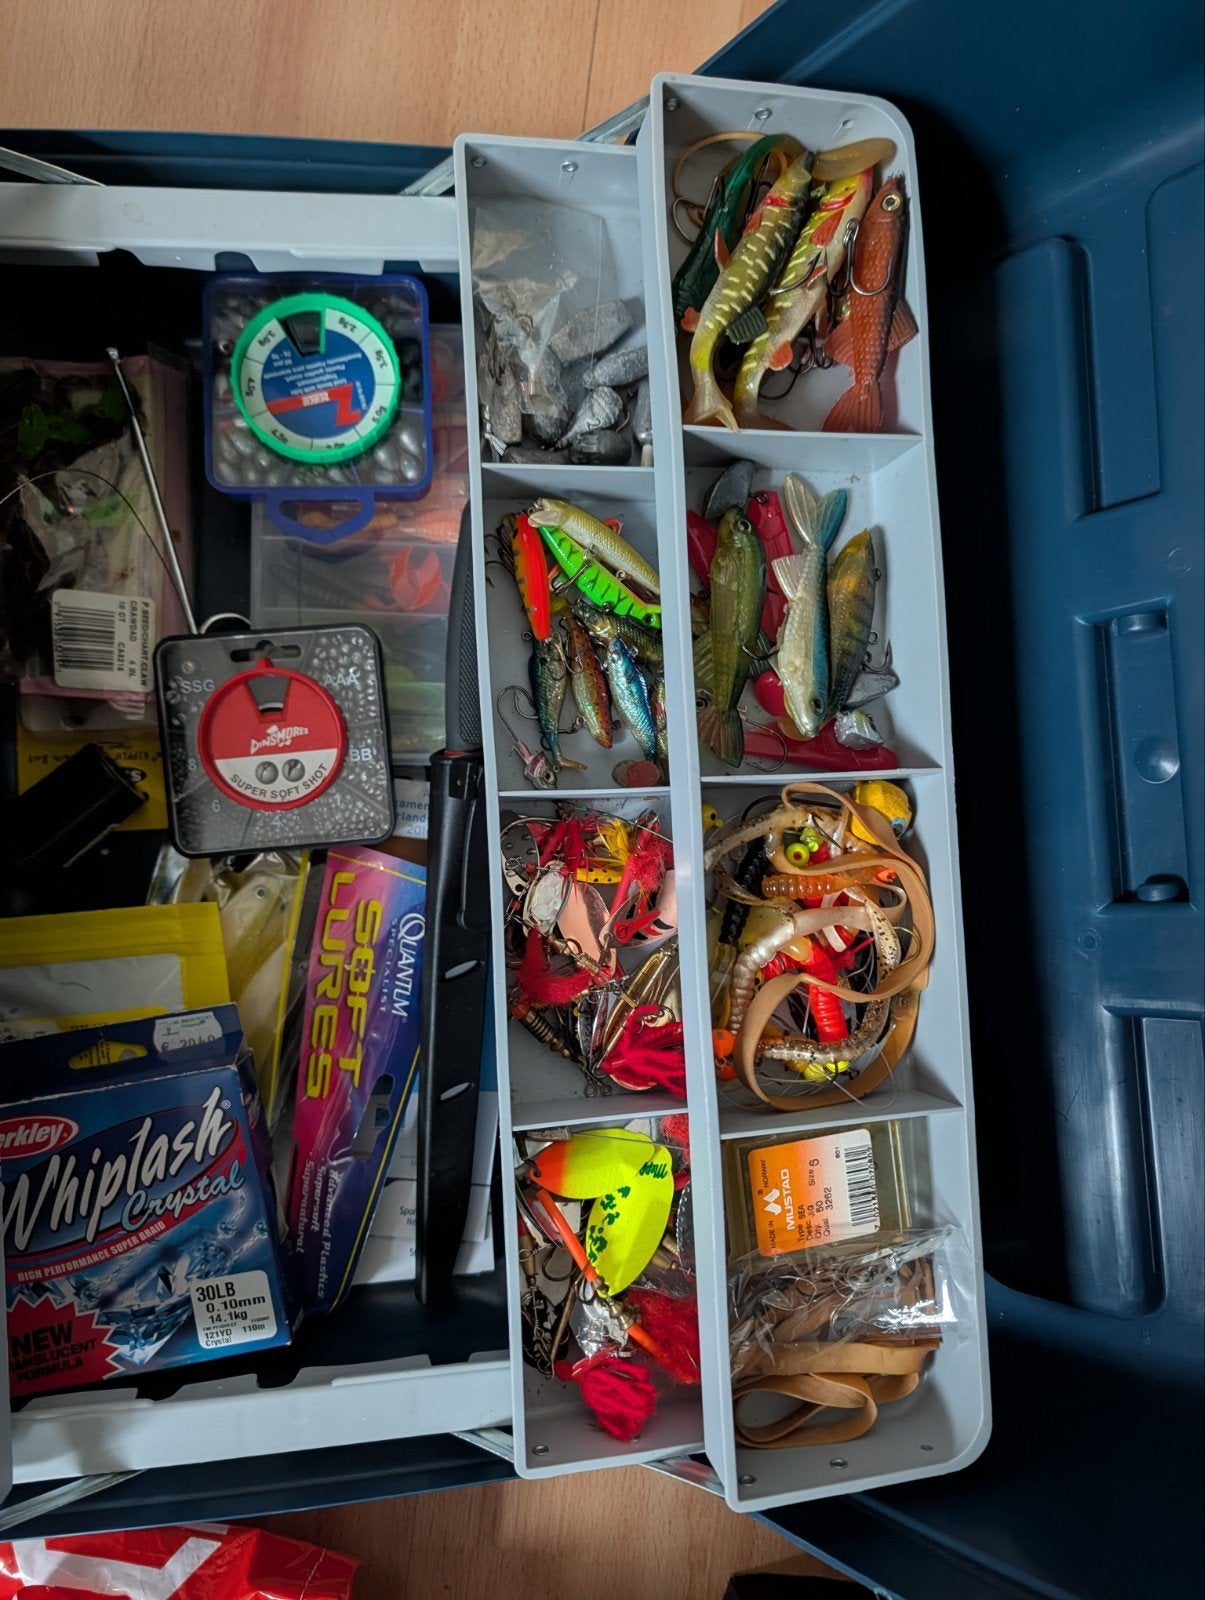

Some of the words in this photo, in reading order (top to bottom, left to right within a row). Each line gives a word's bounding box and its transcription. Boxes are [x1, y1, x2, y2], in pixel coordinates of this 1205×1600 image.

[338, 317, 358, 333] 2.5g
[245, 377, 257, 398] 4.0g
[118, 612, 126, 623] CT
[129, 600, 138, 642] CRAWDAD
[180, 678, 216, 694] SSG
[323, 671, 360, 688] AAA
[187, 758, 197, 772] 8
[350, 747, 374, 763] BB
[230, 773, 268, 799] SUPER
[270, 786, 301, 800] SOFT
[302, 762, 329, 790] SHOT
[211, 799, 222, 813] 6
[271, 814, 283, 827] 4
[379, 917, 398, 1013] SPECIALIST
[391, 912, 426, 1018] QUANTUM
[306, 871, 356, 1099] LURES
[338, 898, 383, 1089] SOFT
[0, 1122, 64, 1149] erkley
[0, 1087, 232, 1250] Whiplash
[760, 1159, 770, 1189] NORWAY
[808, 1169, 816, 1187] Size
[121, 1160, 244, 1231] Crystal
[310, 1164, 326, 1232] Supersoft
[780, 1167, 796, 1232] MUSTAD
[295, 1160, 315, 1254] Supernatural
[797, 1203, 806, 1219] SEA
[797, 1223, 806, 1242] Type
[17, 1270, 43, 1282] HIGH
[44, 1249, 110, 1278] PERFORMANCE
[110, 1236, 141, 1256] SUPER
[140, 1220, 166, 1241] BRAID
[316, 1240, 332, 1299] Plastics
[195, 1281, 235, 1302] 30LB
[206, 1295, 266, 1313] 0.10mm
[208, 1310, 248, 1324] 14.1kg
[11, 1320, 73, 1357] NEW
[204, 1328, 232, 1340] 121YD
[241, 1323, 266, 1333] 110m
[205, 1336, 232, 1347] Crystal
[16, 1356, 83, 1380] FORMULA
